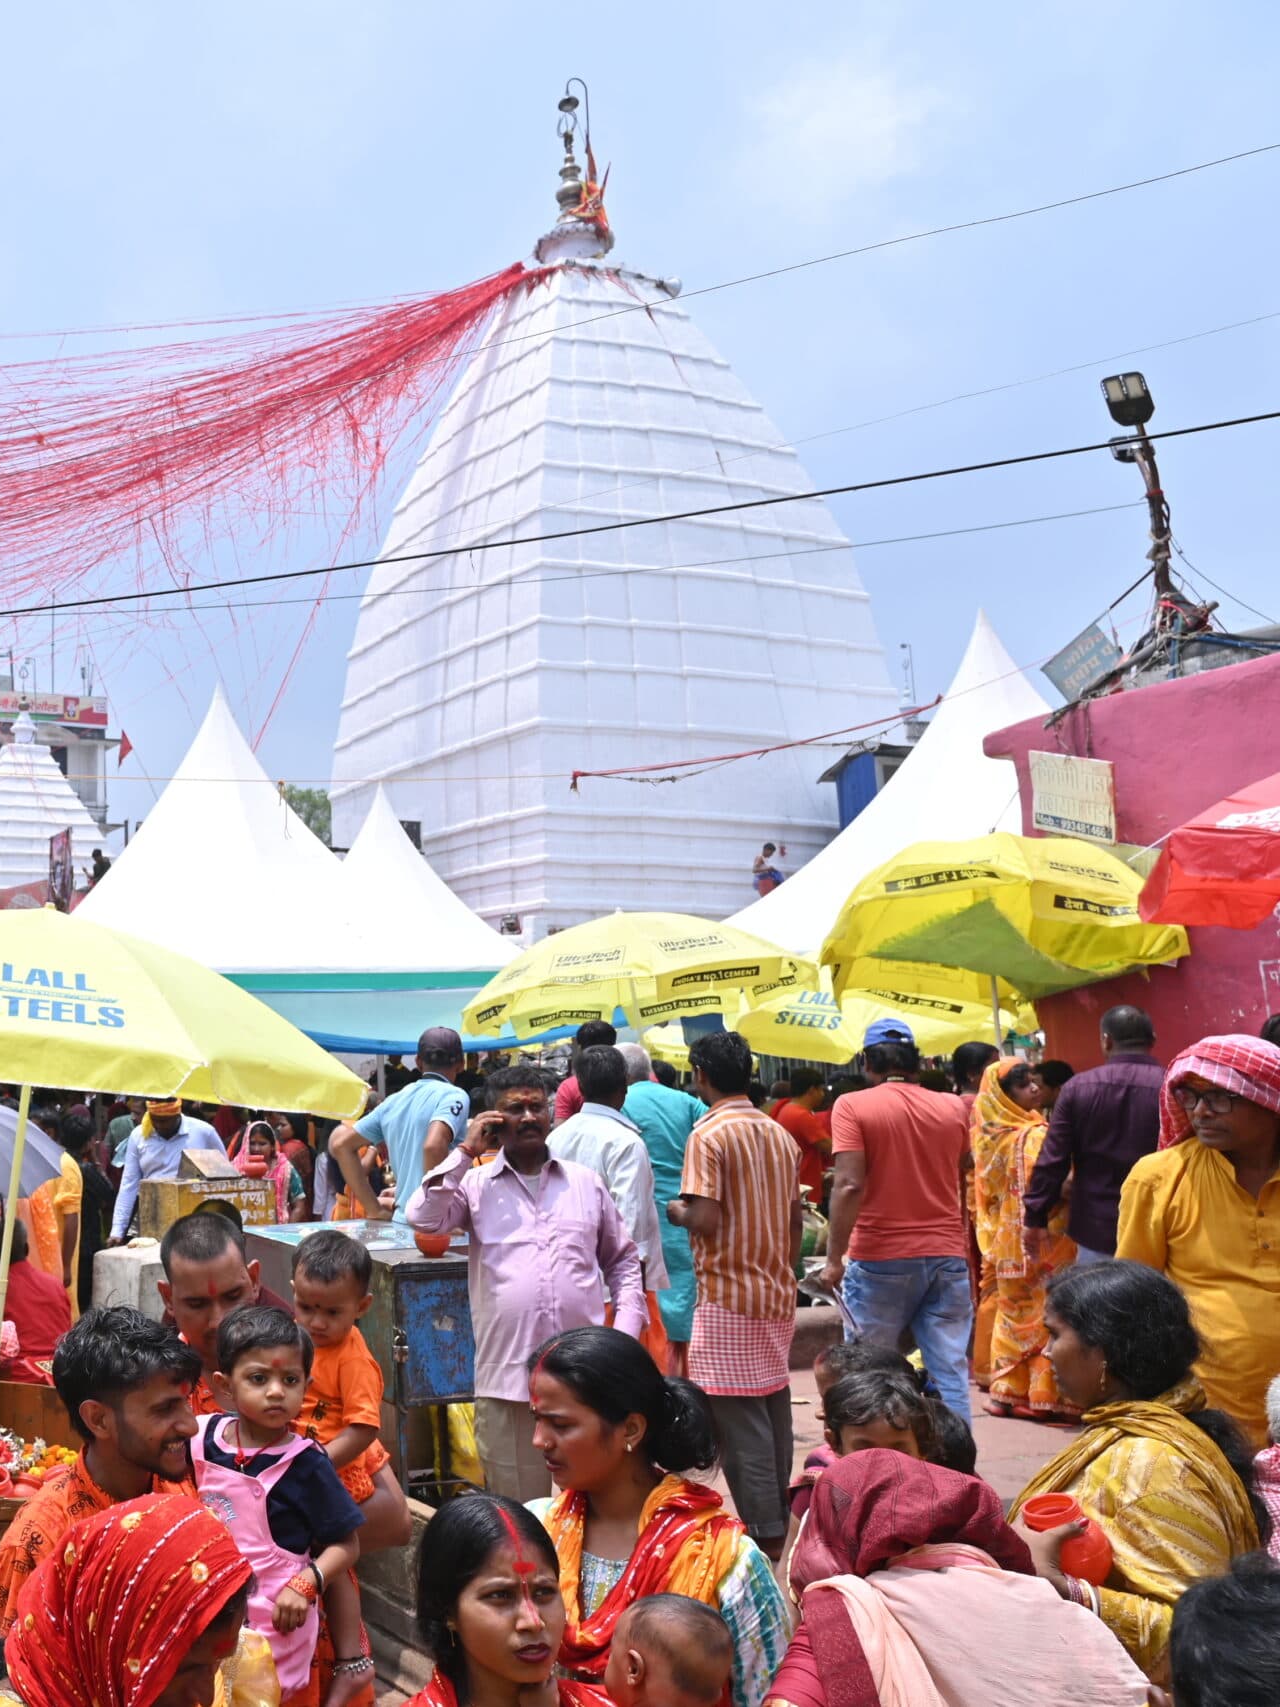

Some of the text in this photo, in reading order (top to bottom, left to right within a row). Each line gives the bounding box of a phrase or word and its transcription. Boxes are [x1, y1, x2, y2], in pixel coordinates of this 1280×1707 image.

[2, 962, 96, 992] LALL
[724, 967, 758, 979] CEMENT
[775, 1010, 842, 1030] STEELS
[451, 1101, 463, 1116] 3
